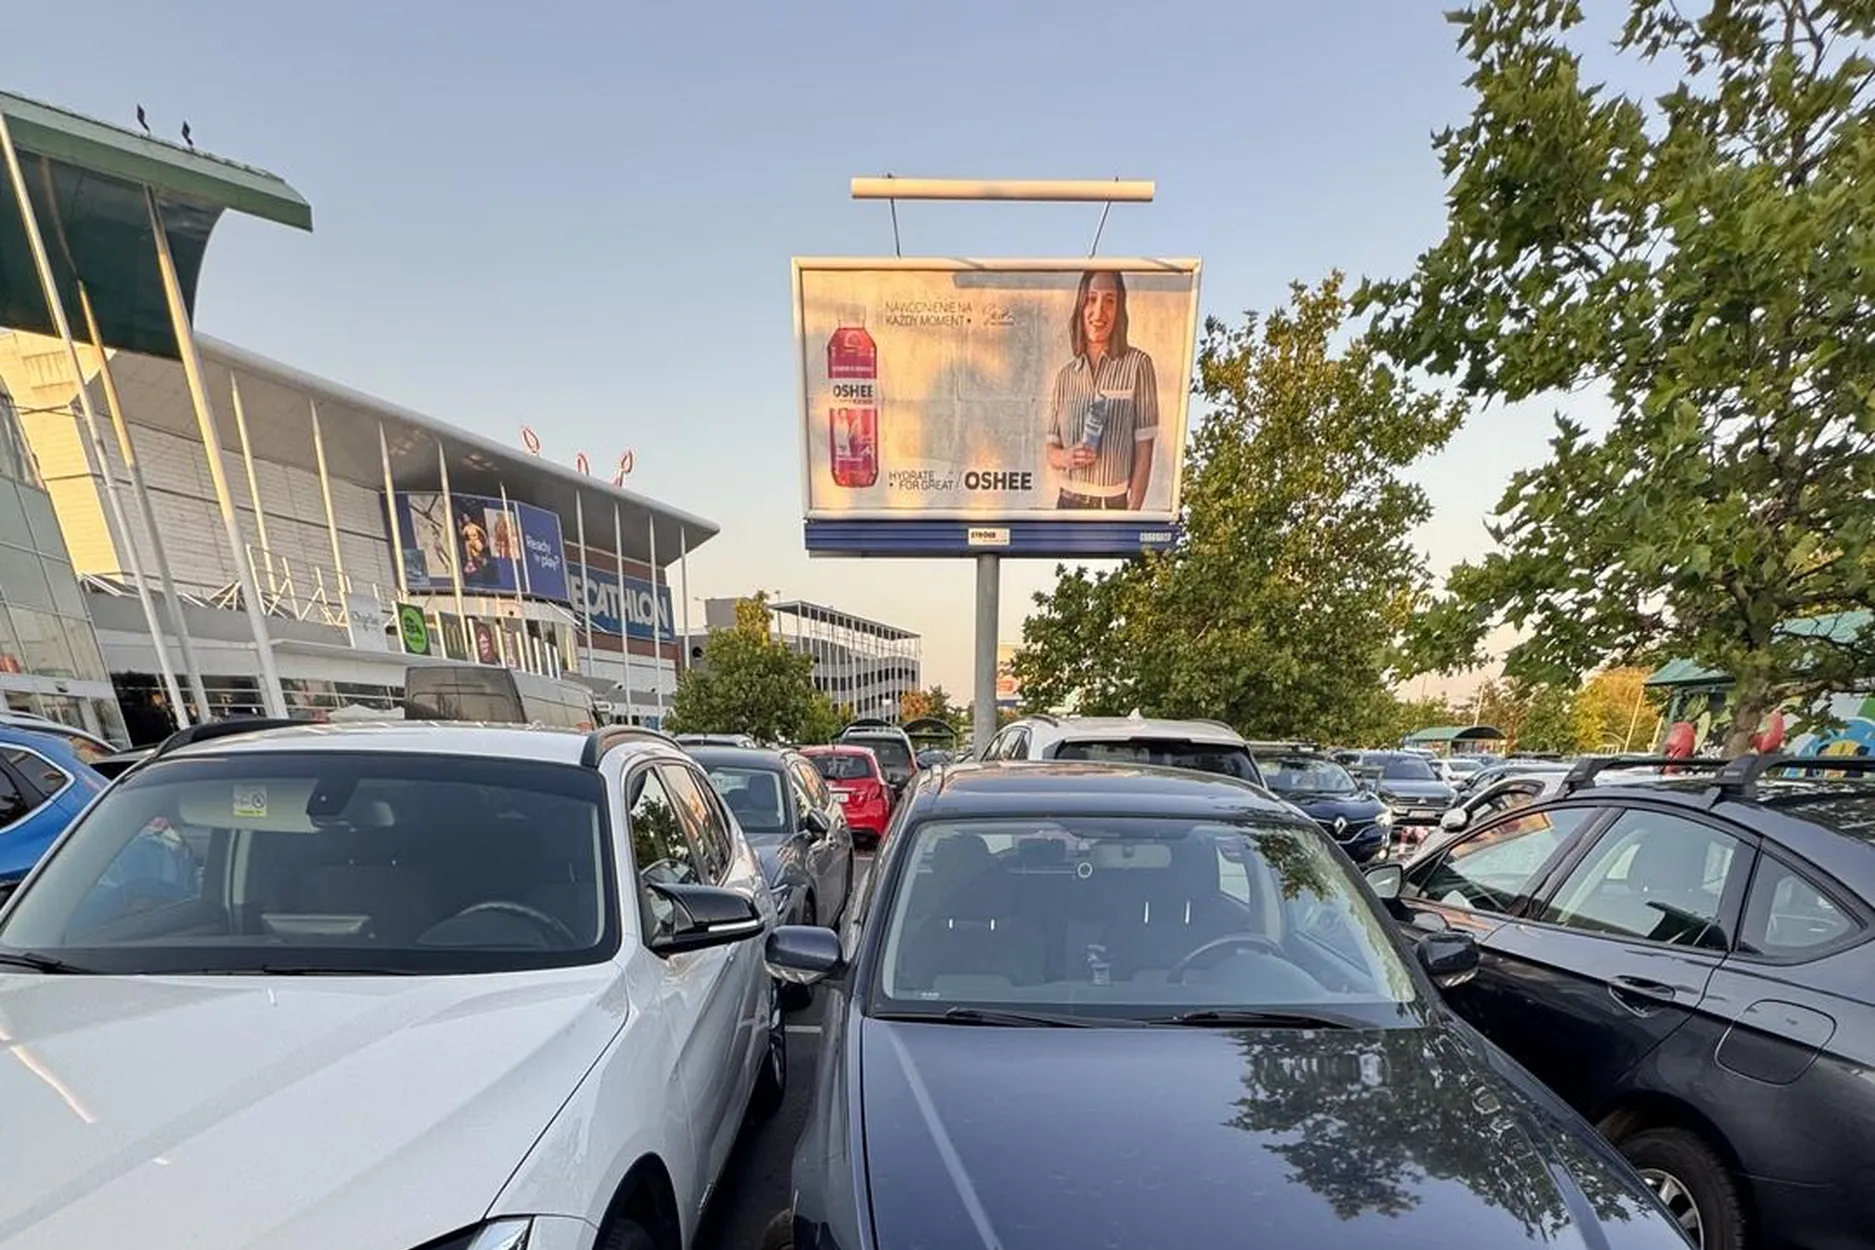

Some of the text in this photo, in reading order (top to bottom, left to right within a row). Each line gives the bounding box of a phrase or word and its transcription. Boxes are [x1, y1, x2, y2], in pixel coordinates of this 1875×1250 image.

[958, 302, 972, 313] NA
[920, 315, 965, 326] MOMENT
[833, 384, 873, 398] OSHEE
[889, 470, 934, 480] HYDRATE
[899, 480, 954, 491] FOR GREAT
[965, 471, 1033, 491] OSHEE
[568, 575, 670, 629] ECATHLON
